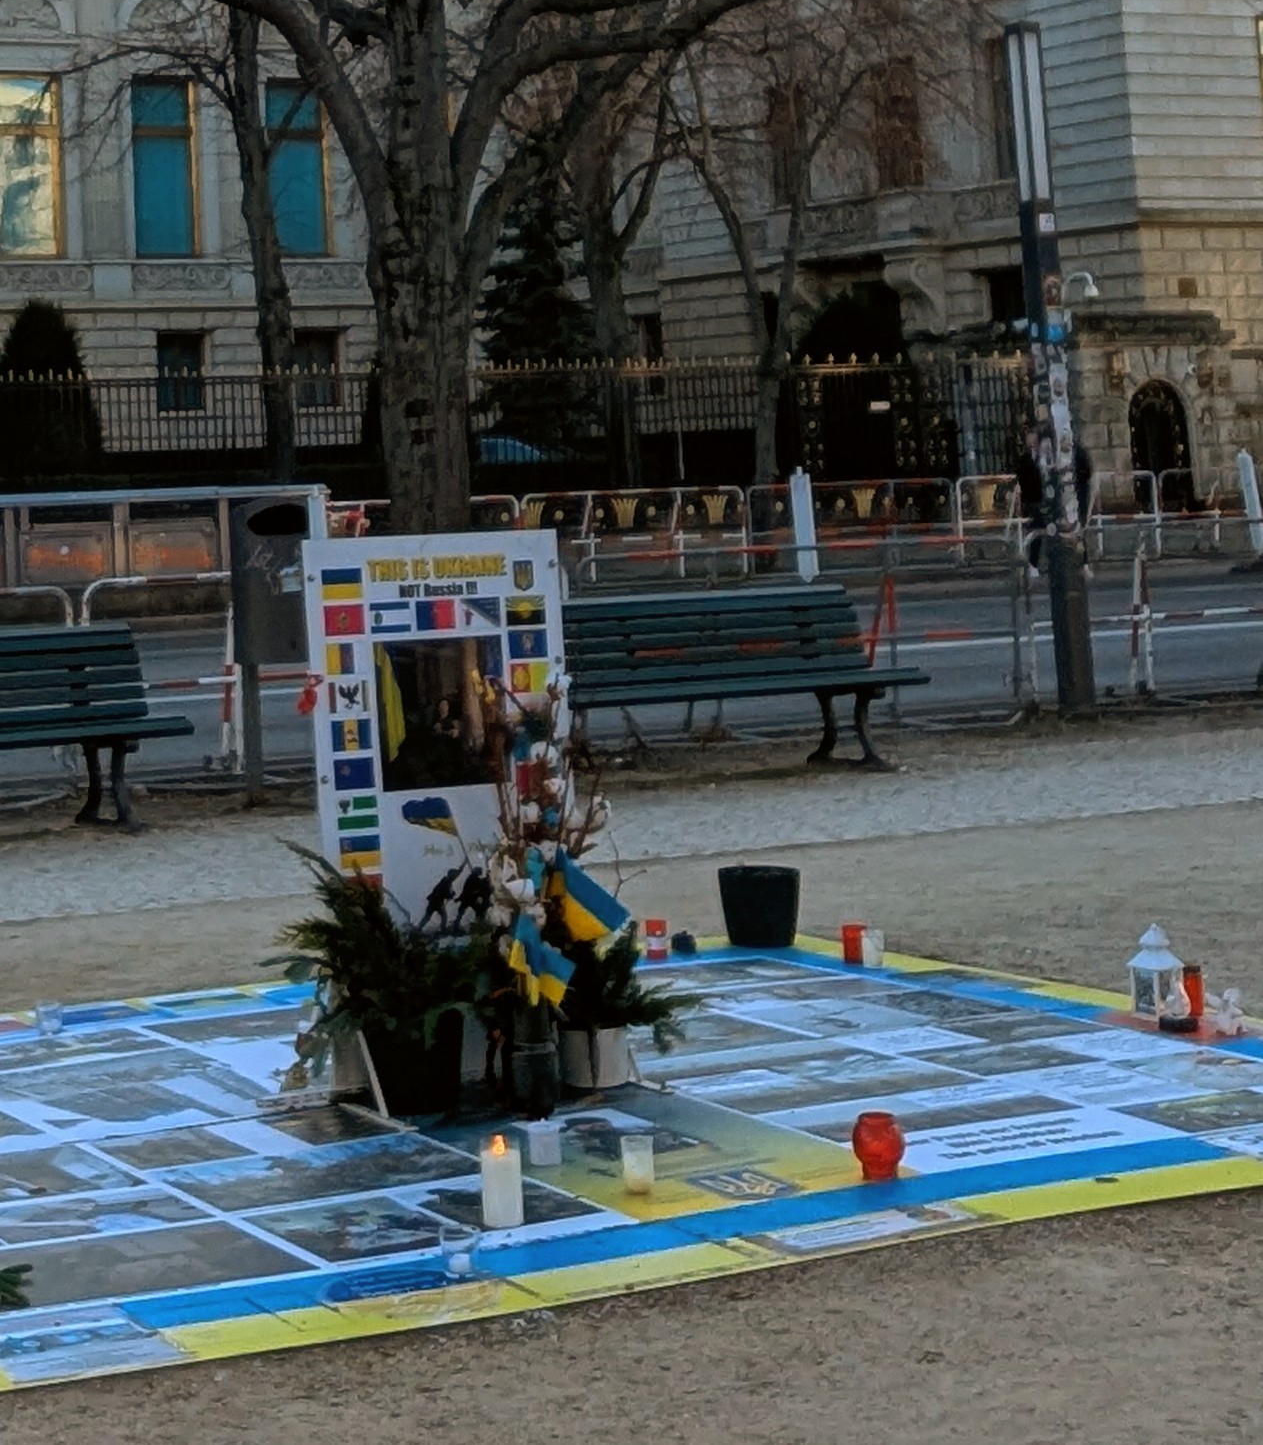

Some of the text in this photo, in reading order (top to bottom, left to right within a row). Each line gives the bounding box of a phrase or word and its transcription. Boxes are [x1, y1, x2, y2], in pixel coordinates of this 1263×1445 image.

[367, 558, 408, 582] THIS
[411, 557, 430, 580] IS
[399, 583, 421, 598] NOT
[424, 582, 464, 597] Russia
